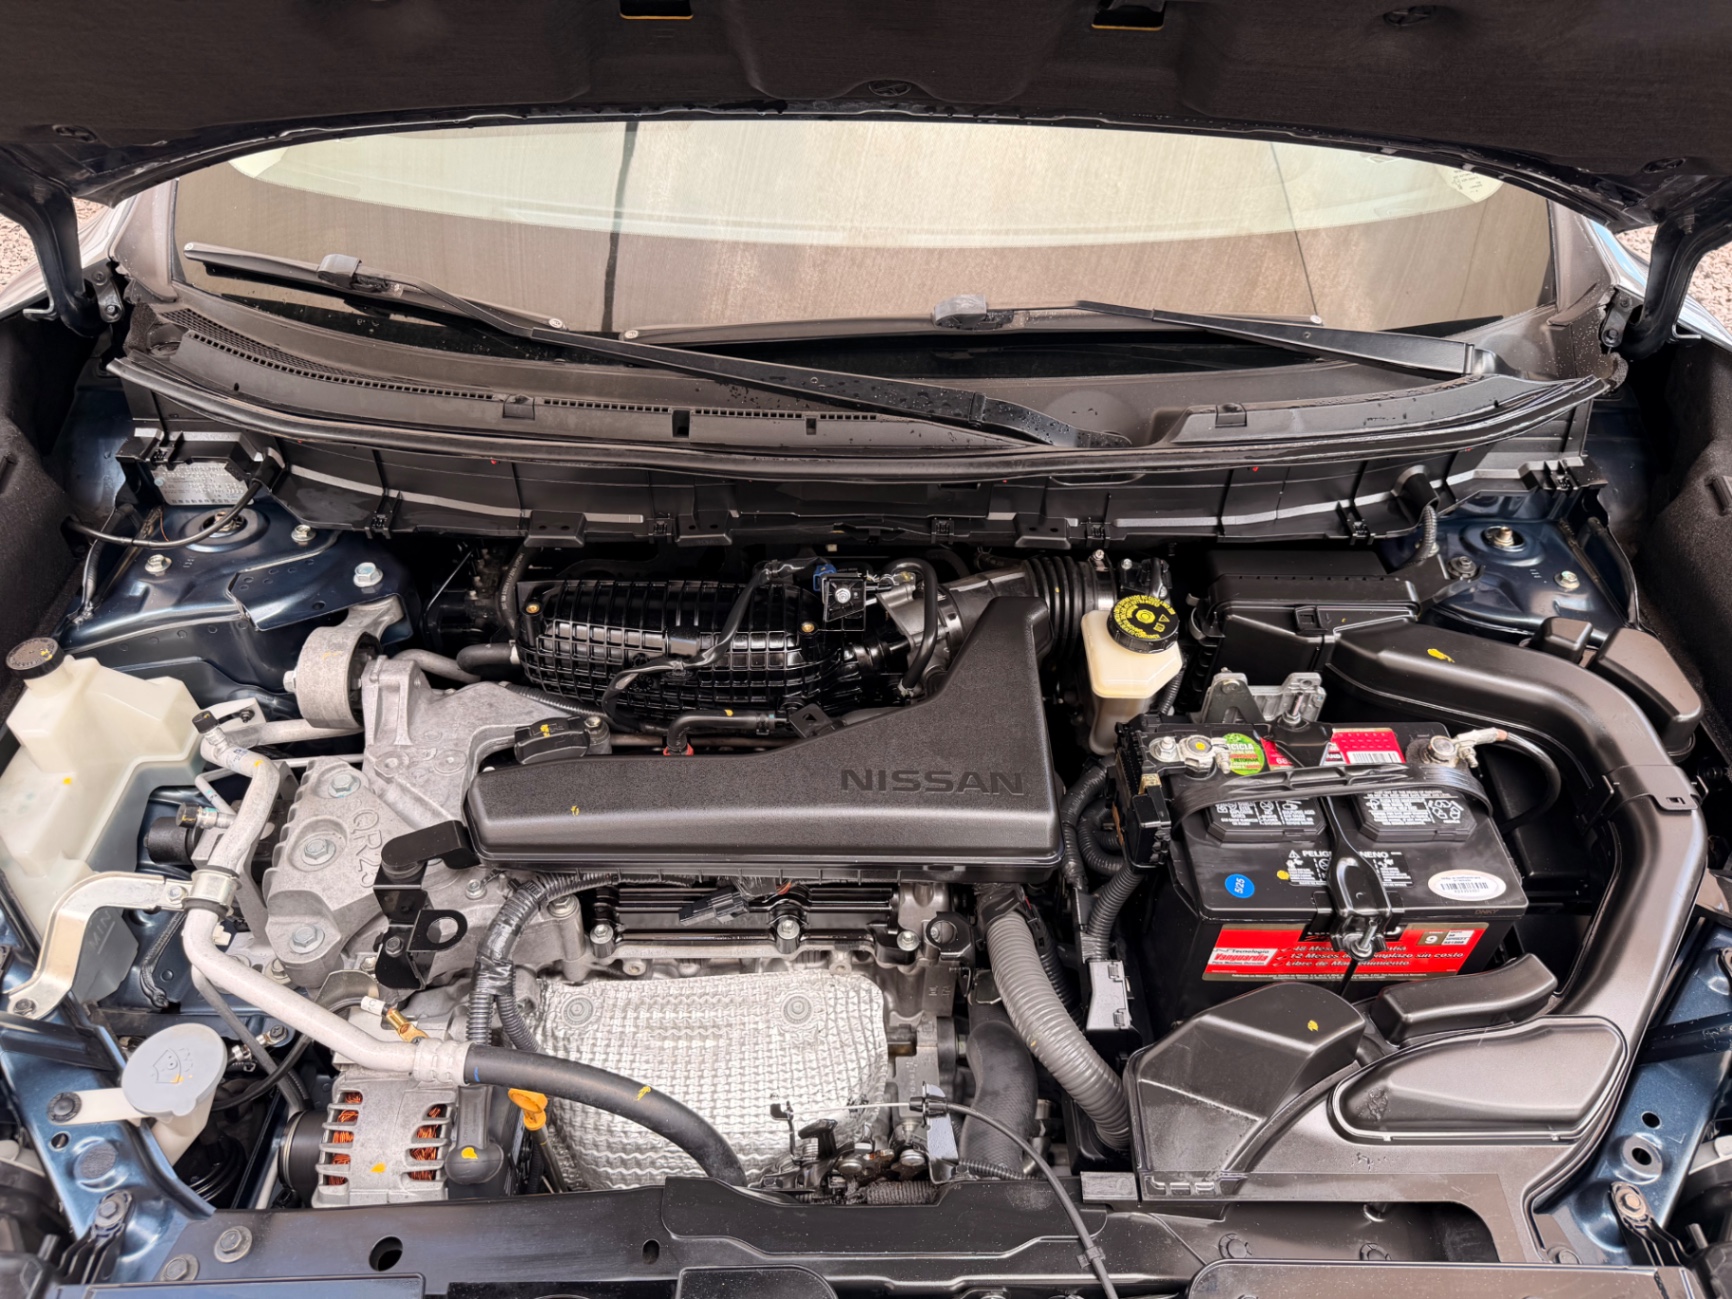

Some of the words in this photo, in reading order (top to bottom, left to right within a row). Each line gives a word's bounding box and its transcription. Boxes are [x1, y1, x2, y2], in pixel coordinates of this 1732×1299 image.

[841, 769, 1024, 795] NISSAN
[1234, 877, 1246, 894] 5/25
[1424, 935, 1439, 944] 9
[1213, 952, 1269, 962] Vanguardia
